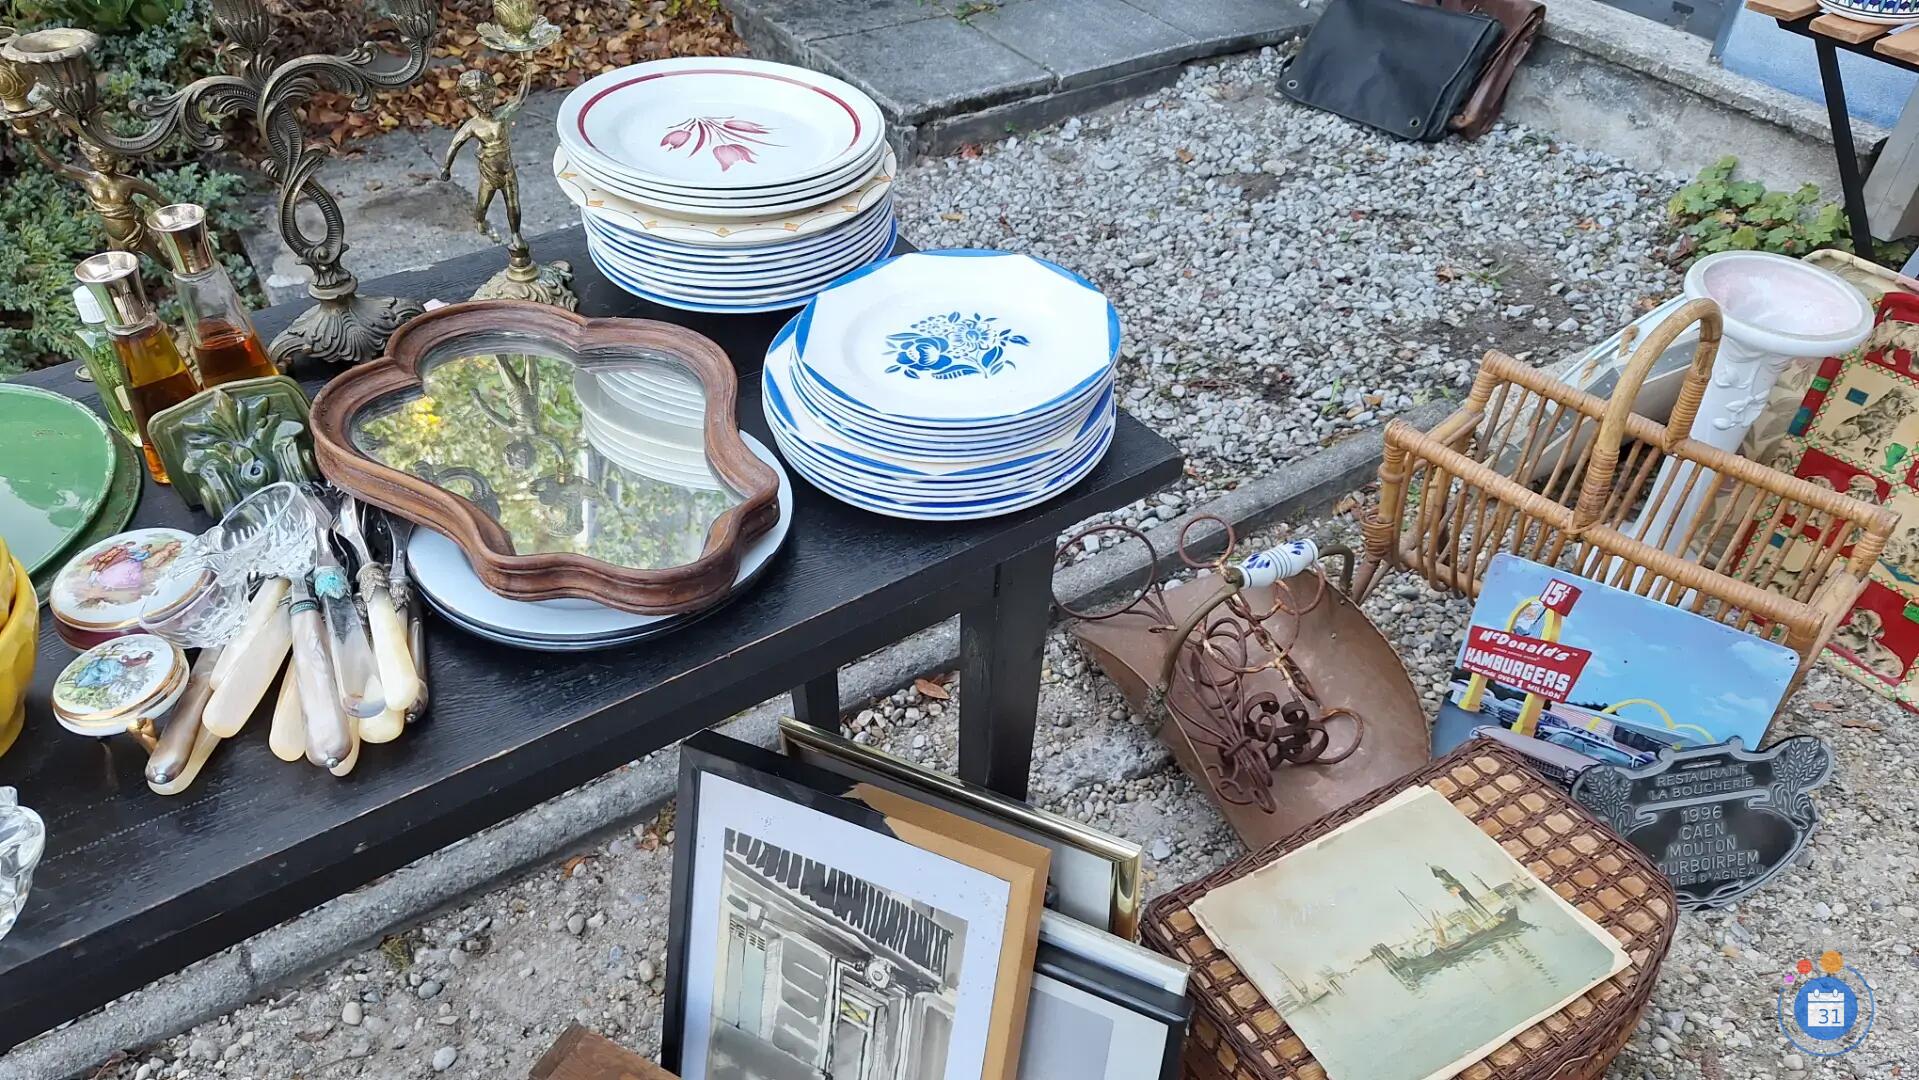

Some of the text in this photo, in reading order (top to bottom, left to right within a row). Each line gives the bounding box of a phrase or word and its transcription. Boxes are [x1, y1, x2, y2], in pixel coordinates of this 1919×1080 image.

[1480, 630, 1570, 661] McDonald's
[1464, 647, 1571, 692] HAMBURGERS
[1498, 674, 1516, 684] OVER
[1517, 680, 1524, 689] 1
[1526, 684, 1561, 700] MILLION
[1656, 765, 1748, 787] RESTAURANT
[1650, 776, 1755, 801] LA BOUCHERIE
[1682, 805, 1722, 823] 1996
[1681, 822, 1725, 840] CAEN
[1668, 837, 1737, 858] MOUTON
[1657, 851, 1760, 876] OURBOIRPEM
[1699, 866, 1765, 883] D'AGNEAU
